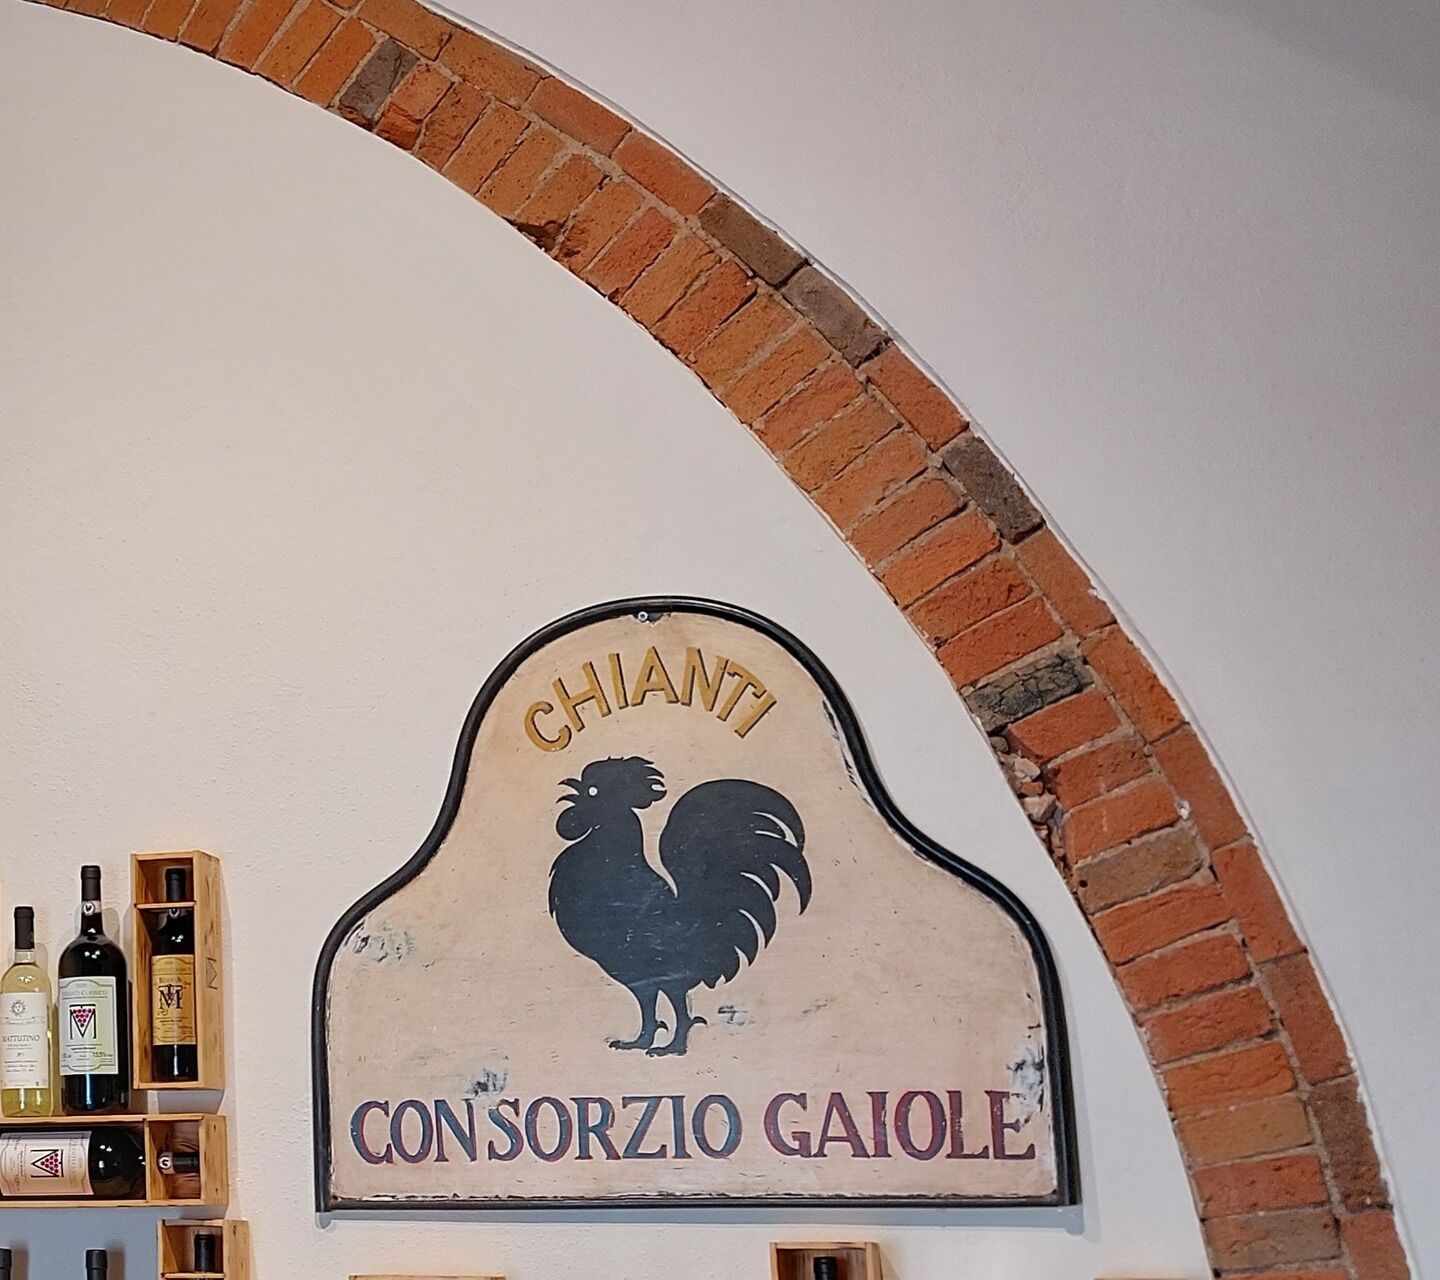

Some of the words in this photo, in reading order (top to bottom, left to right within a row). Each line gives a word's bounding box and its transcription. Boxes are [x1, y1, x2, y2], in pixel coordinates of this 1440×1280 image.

[525, 646, 778, 754] CHIANTI
[350, 1093, 744, 1166] CONSORZIO
[744, 1089, 1037, 1162] GAIOLE
